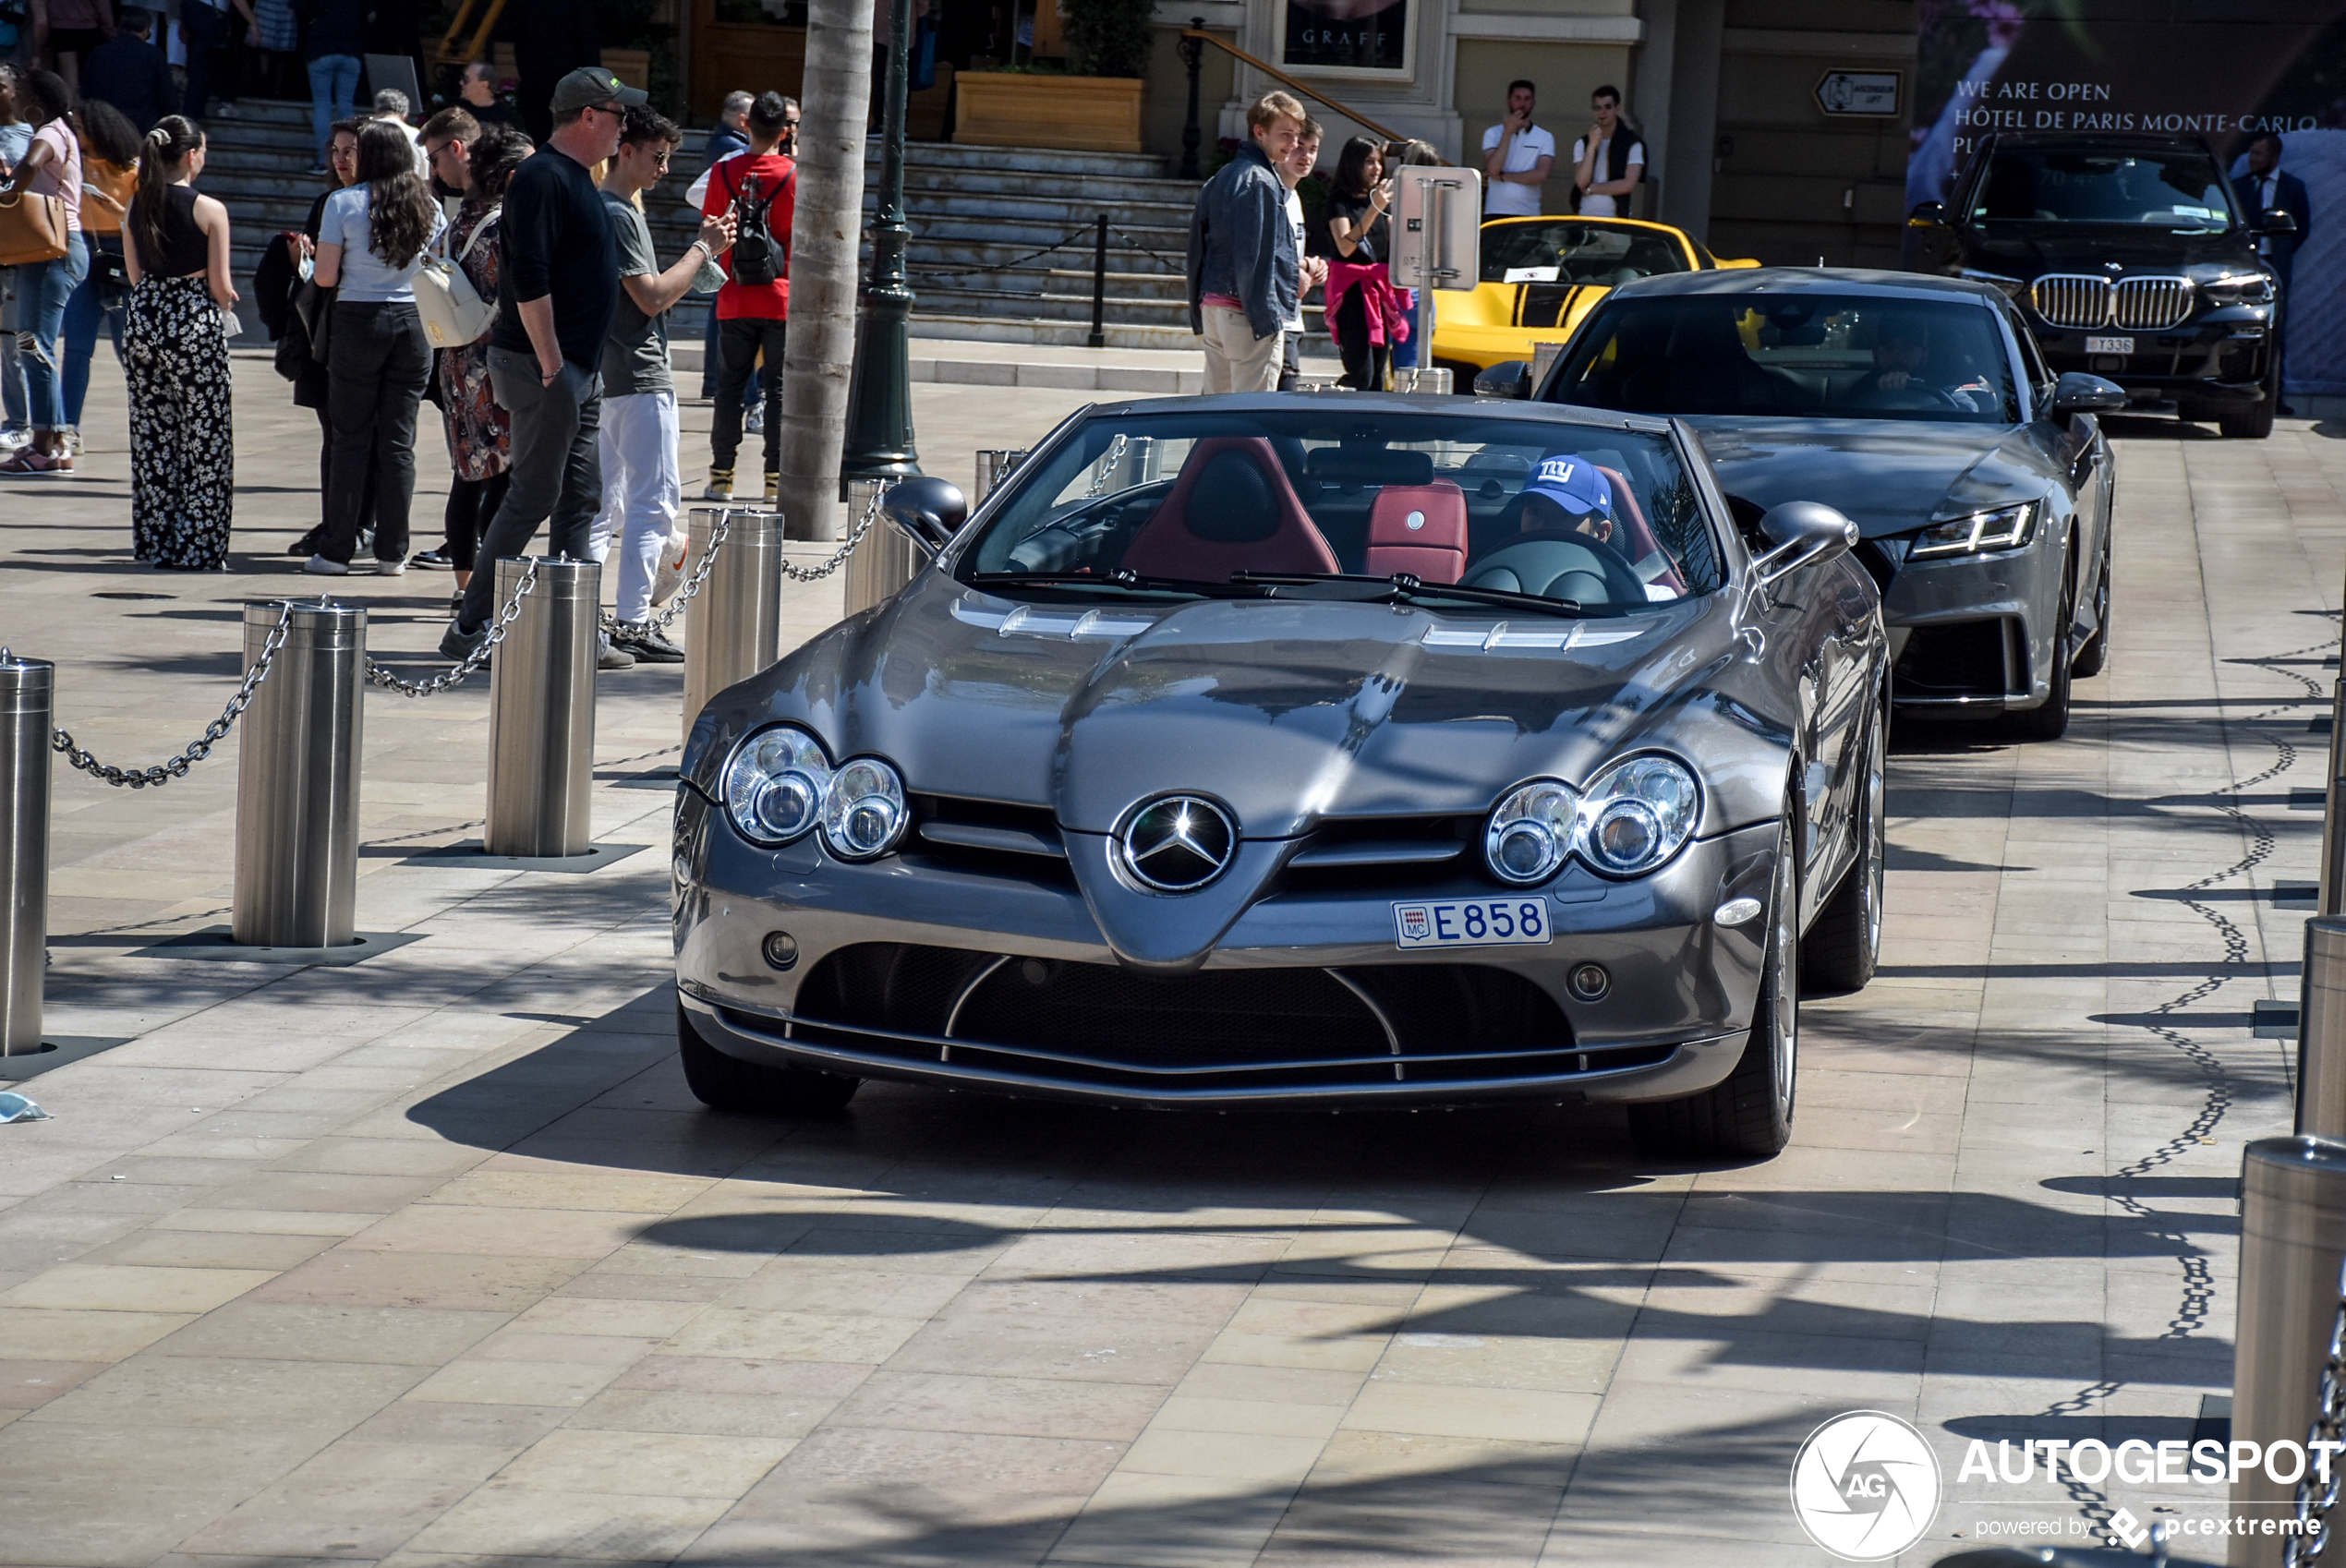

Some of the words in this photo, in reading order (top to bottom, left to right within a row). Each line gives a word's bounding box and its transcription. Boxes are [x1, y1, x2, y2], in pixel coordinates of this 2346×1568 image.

[1301, 29, 1387, 46] GRAFF
[1956, 80, 1991, 99] WE
[1997, 81, 2040, 100] ARE
[2048, 82, 2110, 101] OPEN
[1954, 104, 2028, 128] HÔTEL
[2035, 110, 2066, 129] DE
[2072, 111, 2135, 131] PARIS
[2141, 114, 2318, 133] MONTE-CARLO
[2099, 339, 2132, 352] Y336
[1408, 924, 1426, 935] MC
[1433, 902, 1543, 940] E858
